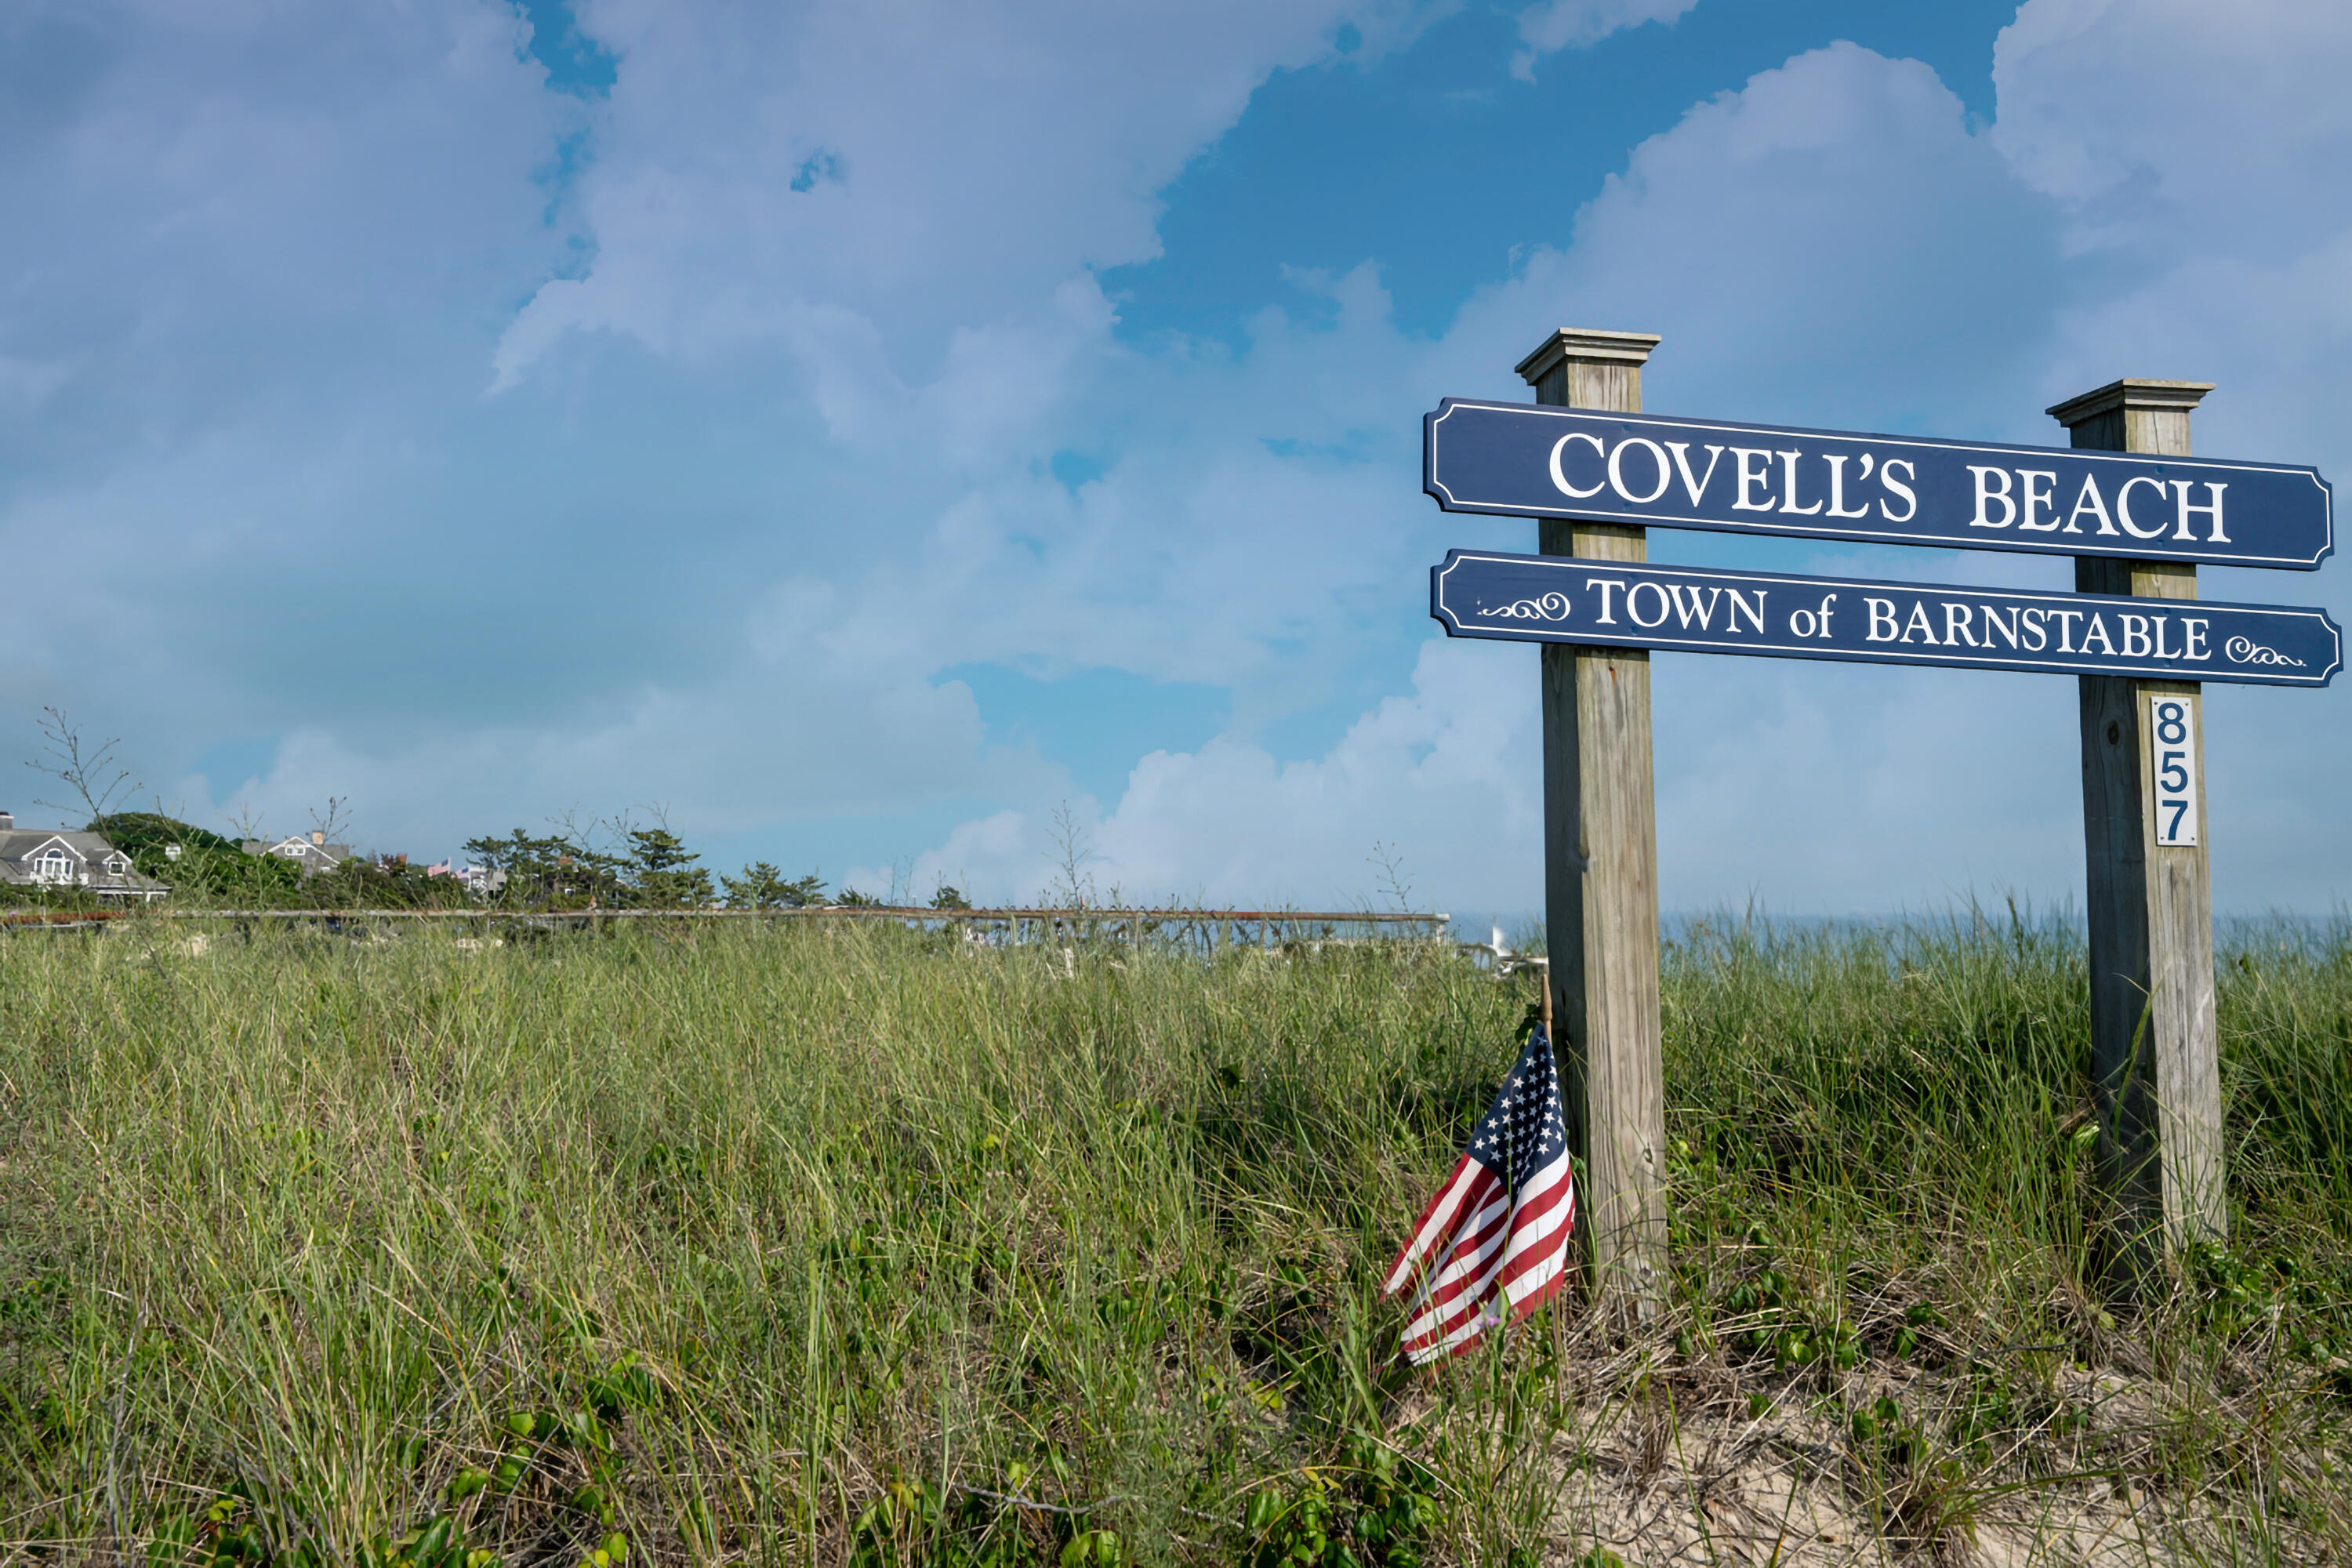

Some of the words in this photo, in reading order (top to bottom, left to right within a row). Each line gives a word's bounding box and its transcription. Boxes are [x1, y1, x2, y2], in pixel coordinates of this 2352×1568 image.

[1965, 465, 2232, 543] BEACH
[1585, 579, 1768, 634] TOWN
[1789, 593, 1837, 638] of
[1863, 597, 2212, 661] BARNSTABLE
[2158, 702, 2188, 841] 857
